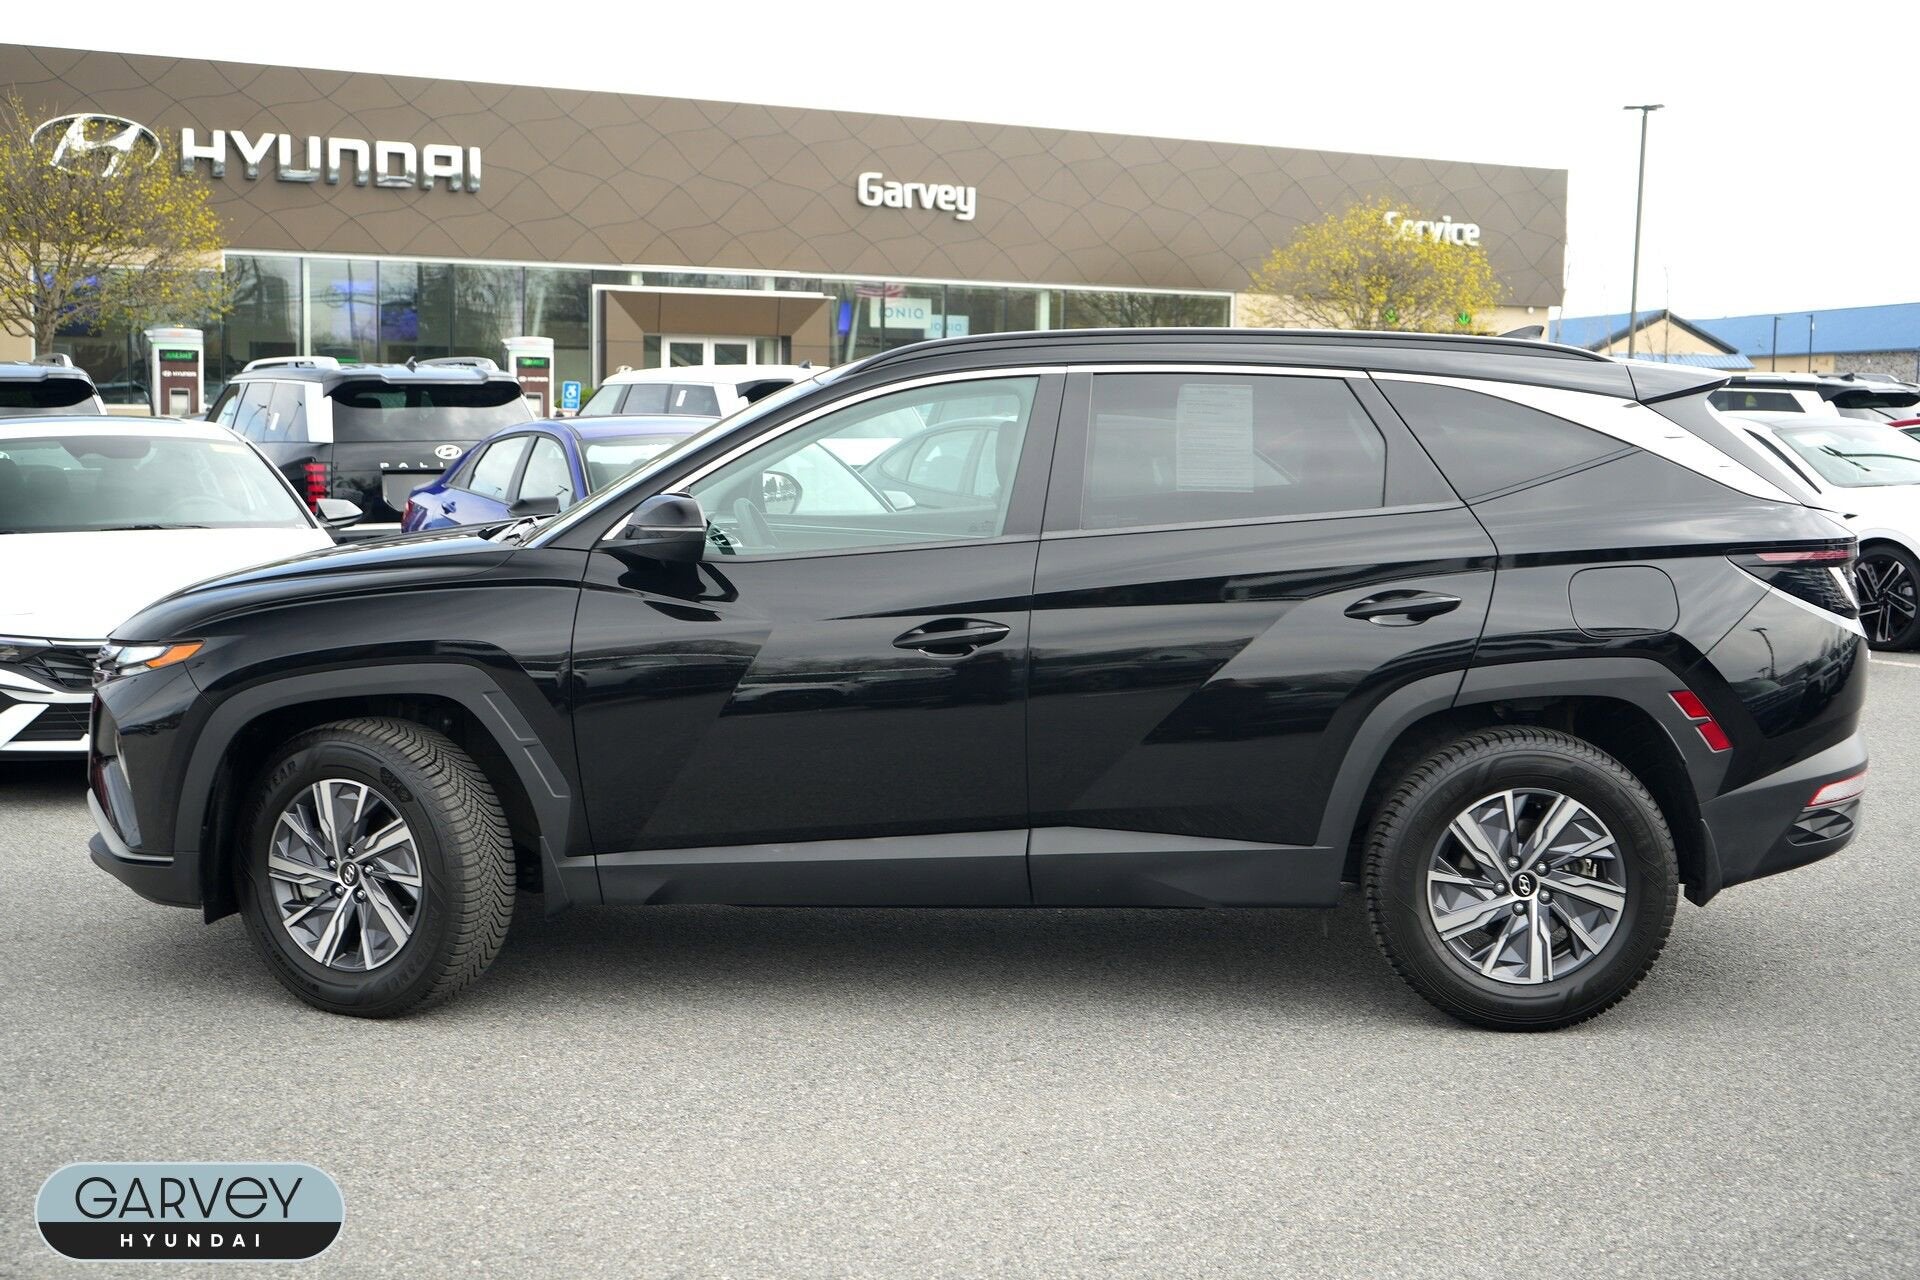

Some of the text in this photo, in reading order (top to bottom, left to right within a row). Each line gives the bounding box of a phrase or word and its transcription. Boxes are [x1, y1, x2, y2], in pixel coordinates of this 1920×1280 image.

[180, 127, 482, 193] HYUNDAI
[857, 171, 977, 221] Garvey
[930, 322, 963, 332] IOIQ
